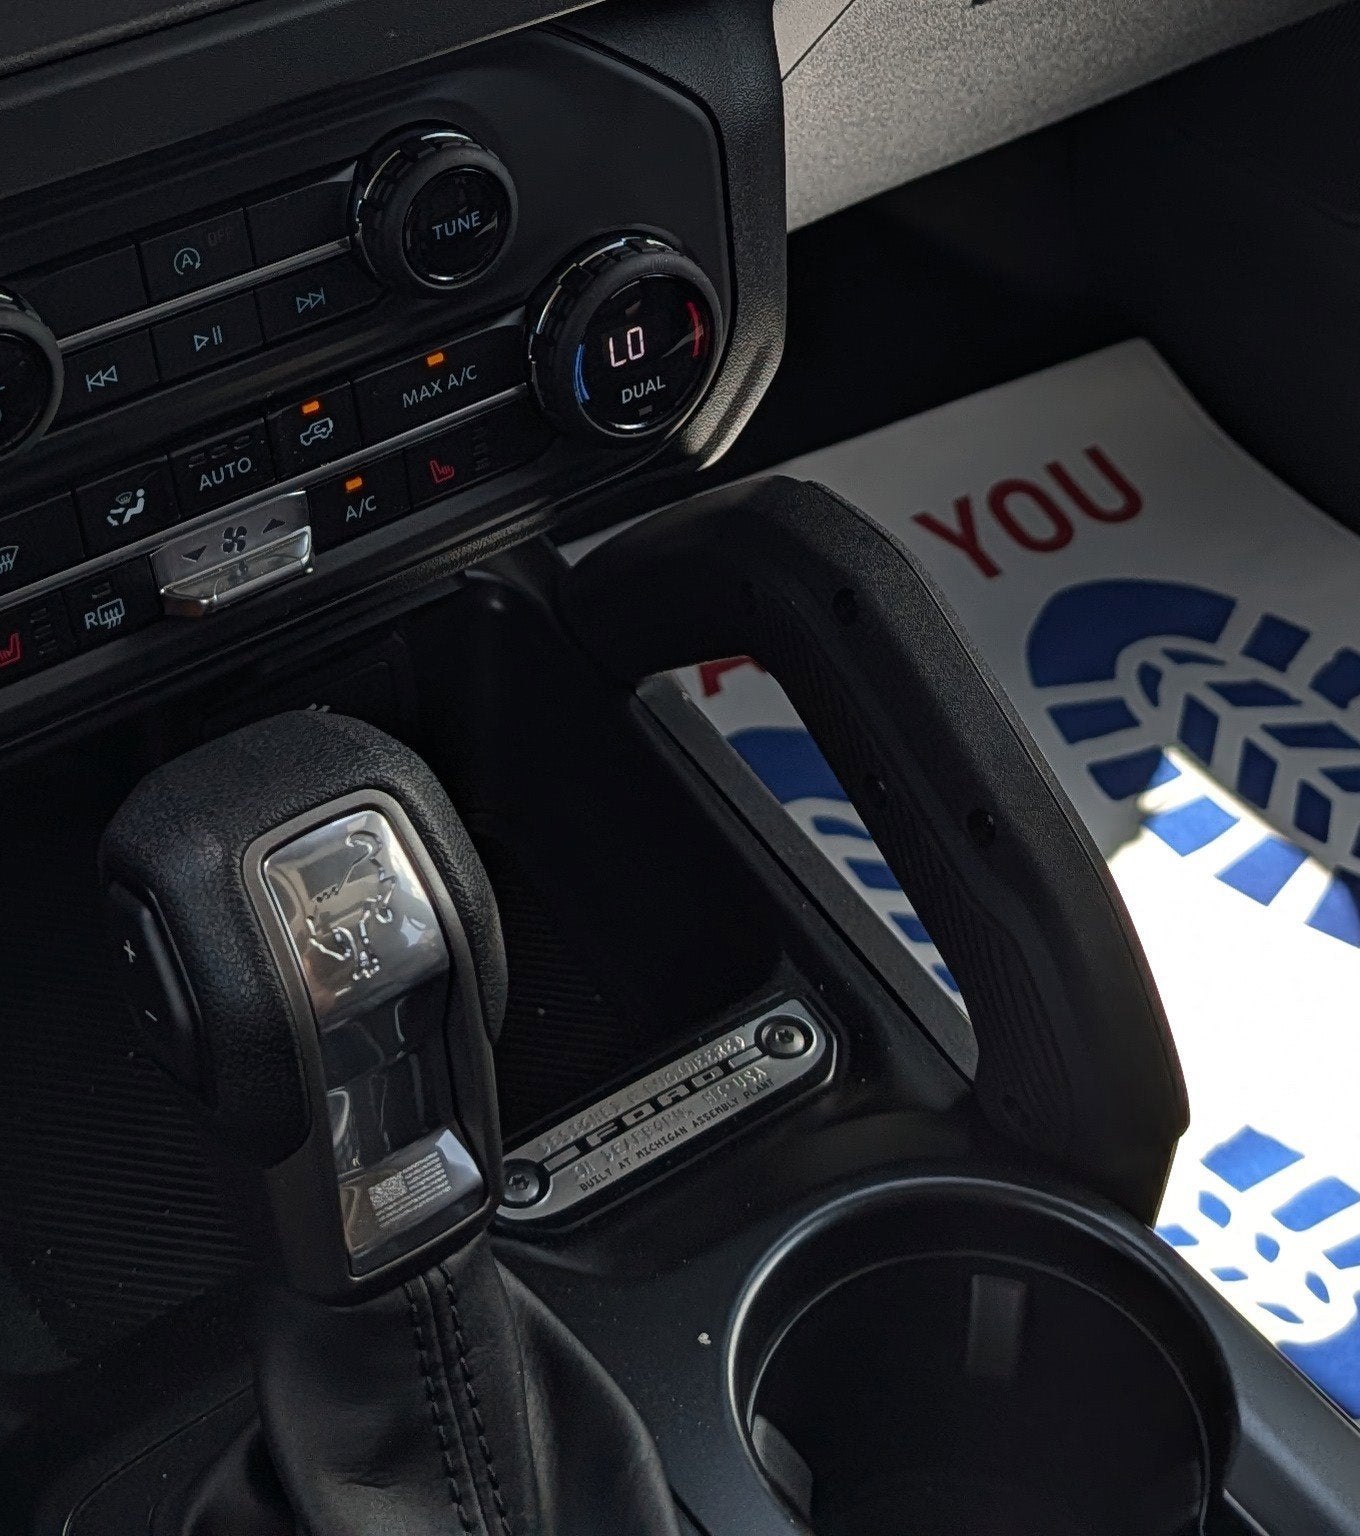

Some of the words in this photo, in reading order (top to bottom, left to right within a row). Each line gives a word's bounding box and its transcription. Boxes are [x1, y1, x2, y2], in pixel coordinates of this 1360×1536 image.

[431, 210, 482, 241] TUNE
[609, 325, 646, 369] LO
[402, 381, 442, 409] MAX
[444, 364, 478, 392] A/C
[620, 374, 667, 406] DUAL
[198, 456, 254, 491] AUTO
[344, 493, 378, 523] A/C
[911, 444, 1144, 580] YOU
[586, 1065, 725, 1147] FORD
[579, 1168, 614, 1192] BUILT
[618, 1157, 632, 1170] AT
[635, 1126, 688, 1165] MICHIGAN
[692, 1099, 740, 1129] ASSEMBLY
[743, 1078, 775, 1100] PLANT
